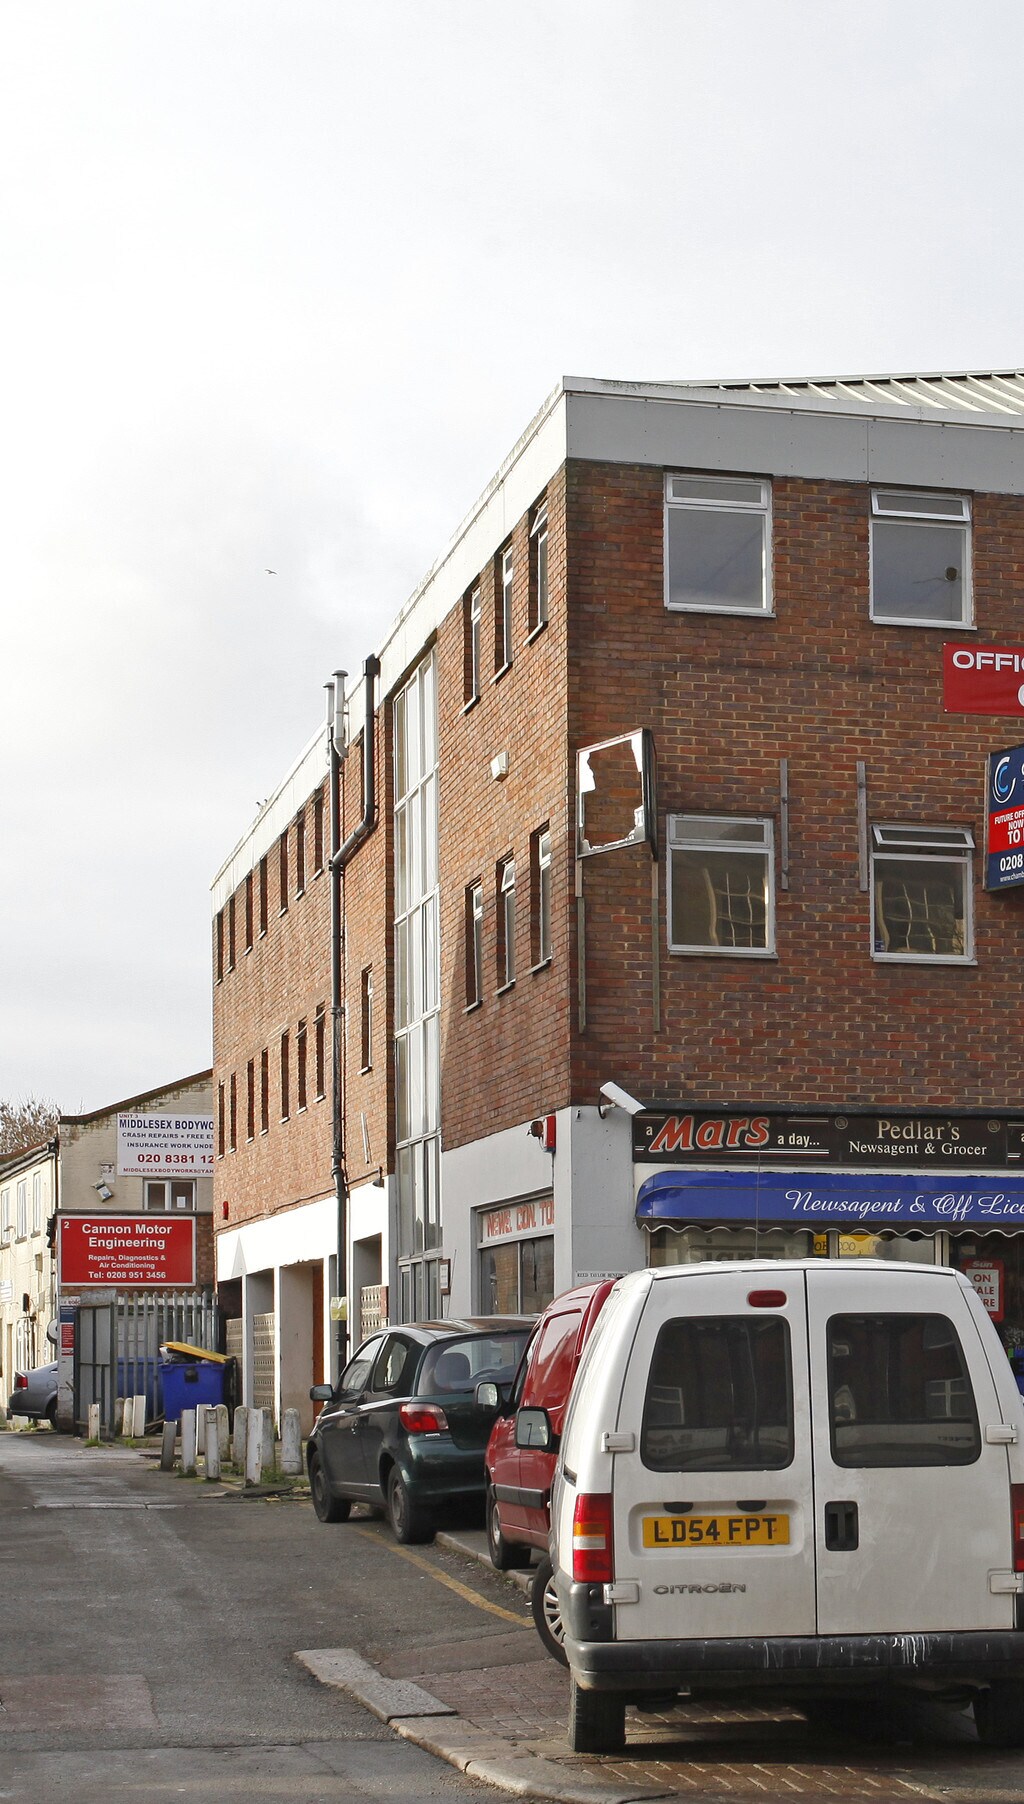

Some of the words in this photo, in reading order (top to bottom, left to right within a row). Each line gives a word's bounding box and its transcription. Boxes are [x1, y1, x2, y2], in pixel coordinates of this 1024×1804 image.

[994, 812, 1013, 824] FUTURE
[1008, 819, 1024, 830] NOW
[1008, 829, 1020, 845] TO
[1000, 854, 1022, 872] 0208
[120, 1119, 172, 1129] MIDDLESEX
[646, 1126, 653, 1136] a
[649, 1115, 770, 1153] Mars
[877, 1120, 960, 1141] Pedlar's
[777, 1135, 784, 1145] a
[788, 1133, 820, 1148] day...
[849, 1141, 919, 1156] Newsagent
[924, 1142, 936, 1155] &
[941, 1143, 987, 1156] Grocer
[138, 1154, 160, 1163] 020
[165, 1154, 194, 1163] 8381
[785, 1190, 904, 1219] Newsagent
[909, 1195, 926, 1213] &
[932, 1193, 974, 1221] Off
[64, 1221, 70, 1229] 2
[82, 1223, 131, 1234] Cannon
[135, 1223, 172, 1234] Motor
[88, 1237, 165, 1250] Engineering
[106, 1271, 126, 1279] 0208
[129, 1271, 143, 1279] 951
[146, 1271, 166, 1279] 3456
[973, 1273, 991, 1283] ON
[977, 1286, 994, 1295] ALE
[983, 1298, 995, 1307] RE
[654, 1519, 720, 1543] LD54
[728, 1518, 777, 1541] FPT
[653, 1582, 747, 1595] CITROËN
